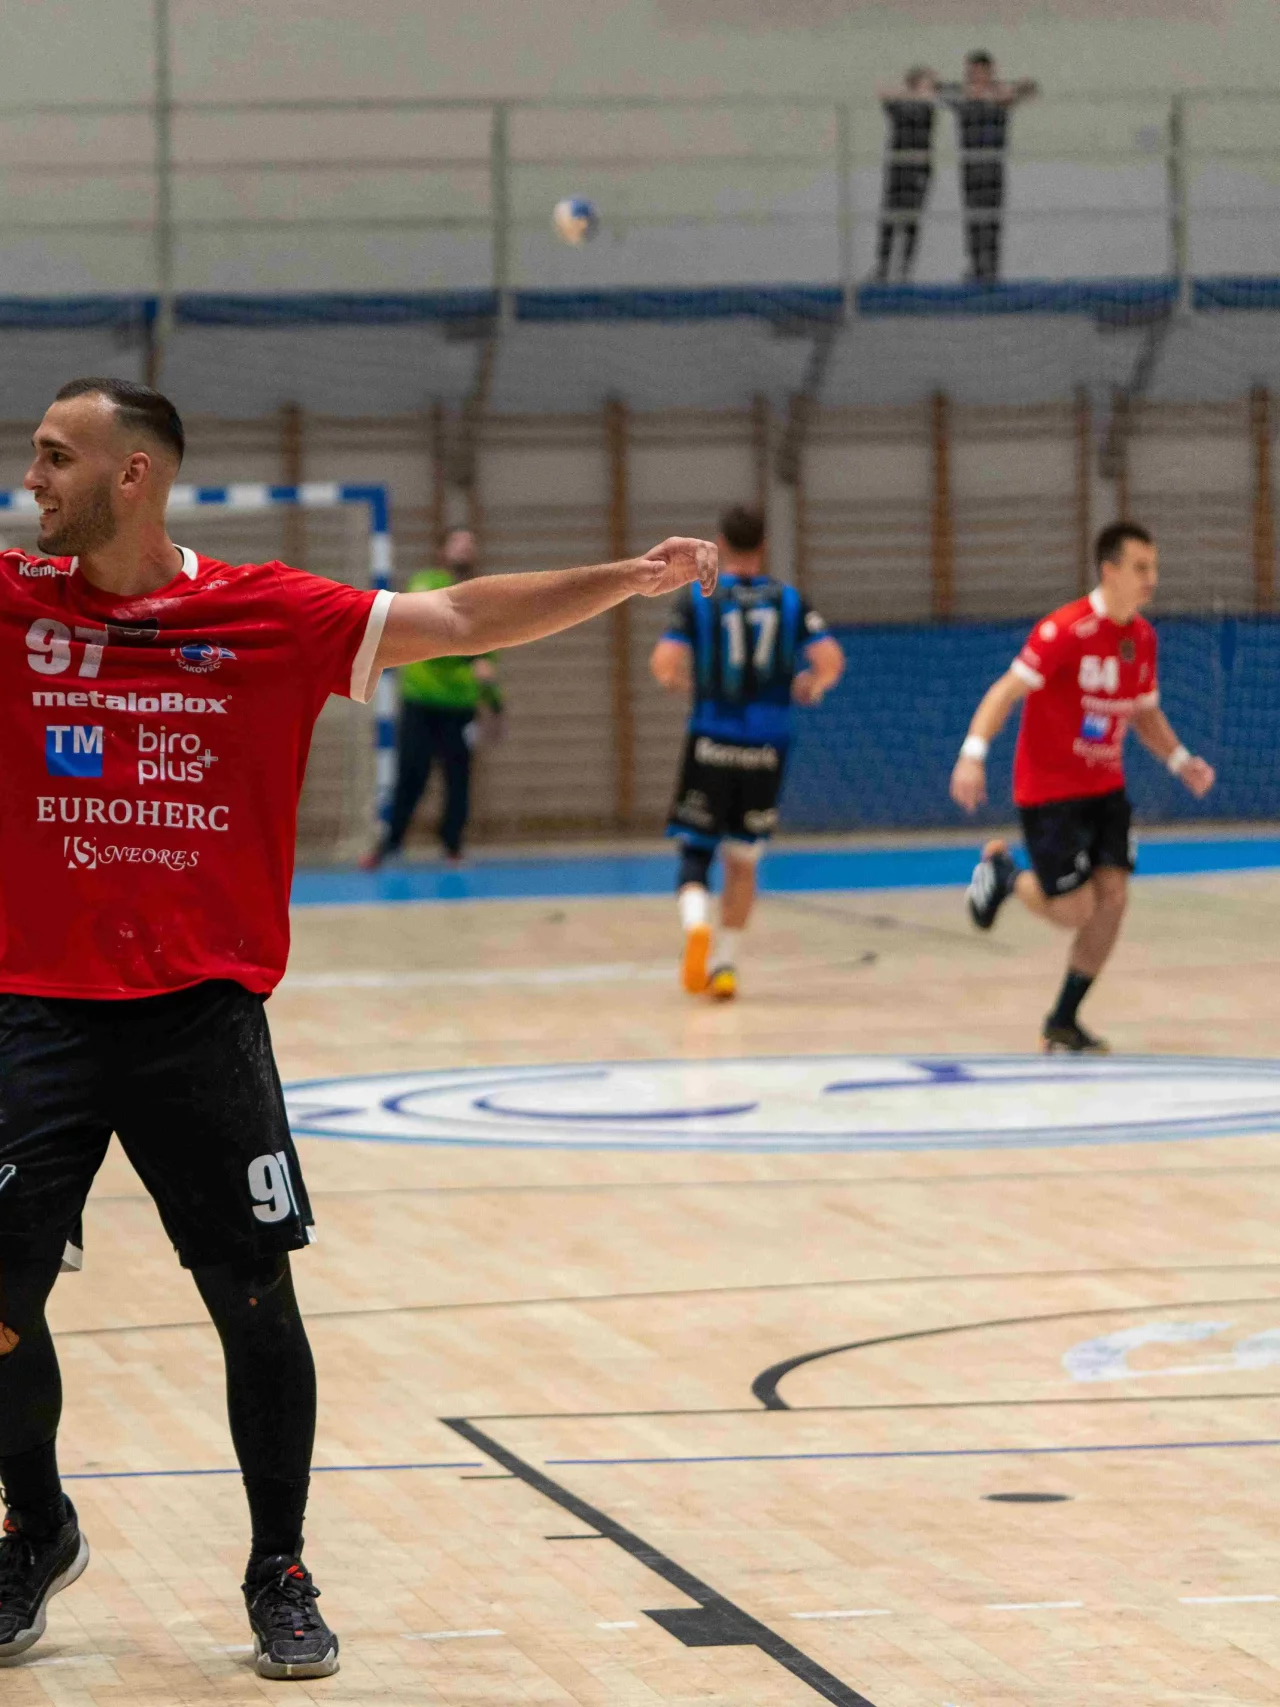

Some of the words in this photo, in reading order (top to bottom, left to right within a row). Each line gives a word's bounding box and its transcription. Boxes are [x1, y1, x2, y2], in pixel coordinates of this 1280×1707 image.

[26, 617, 110, 679] 97
[722, 606, 779, 668] 17
[46, 725, 104, 755] TM
[138, 723, 201, 754] biro
[36, 796, 230, 831] EUROHERC
[97, 845, 200, 872] NEORES
